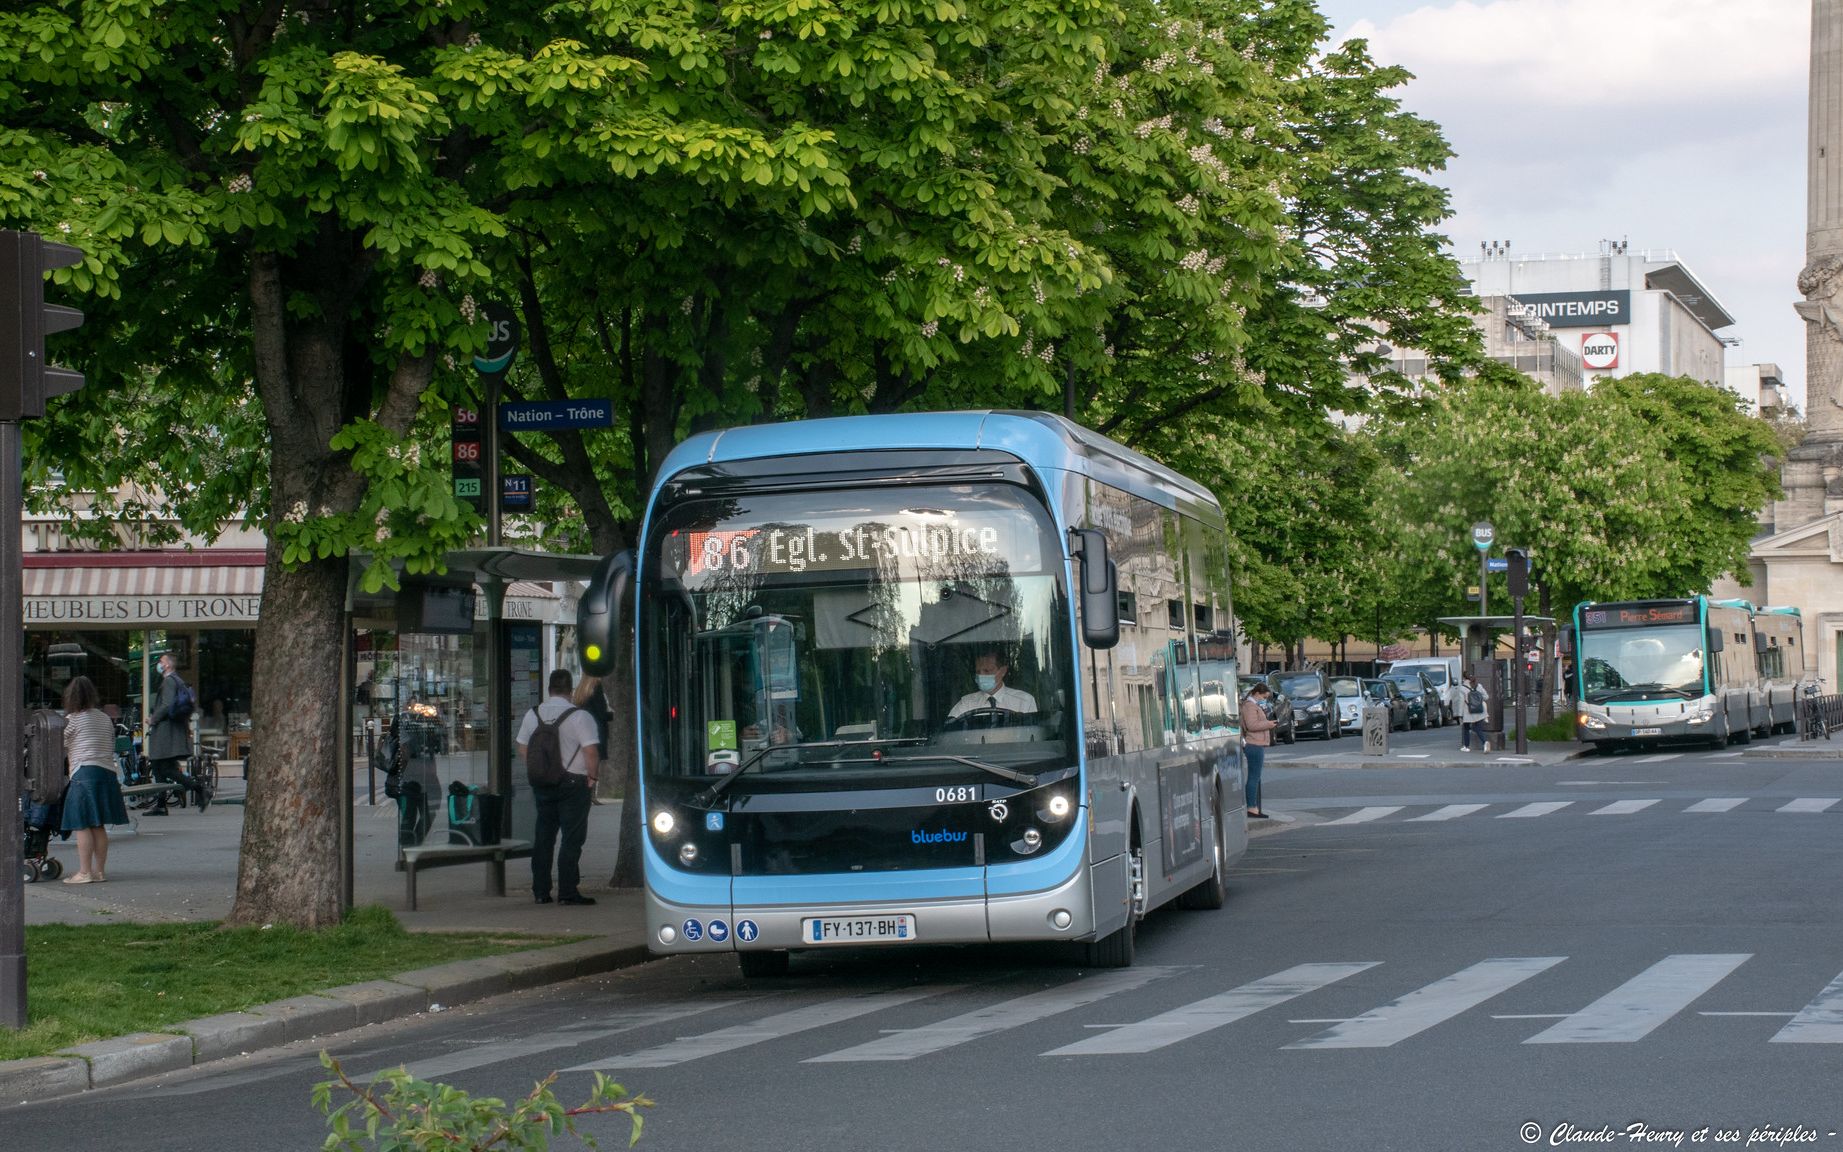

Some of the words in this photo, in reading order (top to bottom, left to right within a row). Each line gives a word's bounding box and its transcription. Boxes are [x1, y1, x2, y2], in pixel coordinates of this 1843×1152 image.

[1524, 300, 1620, 317] RINTEMPS
[488, 320, 510, 342] US
[1583, 345, 1616, 356] DARTY
[457, 408, 478, 423] 56
[507, 410, 552, 423] Nation
[566, 407, 605, 420] Trône
[457, 443, 478, 459] 86
[459, 482, 478, 493] 215
[1475, 528, 1492, 537] BUS
[703, 536, 749, 571] 86
[769, 527, 828, 572] Egl.
[838, 520, 998, 563] St-Sulpice
[136, 600, 171, 619] DU
[178, 598, 261, 618] TRONE
[506, 600, 533, 619] TRONE
[1620, 609, 1649, 623] Pierre
[1585, 611, 1607, 625] 351
[935, 786, 976, 803] 0681
[911, 828, 968, 844] bluebus
[823, 920, 896, 938] FY-137-BH
